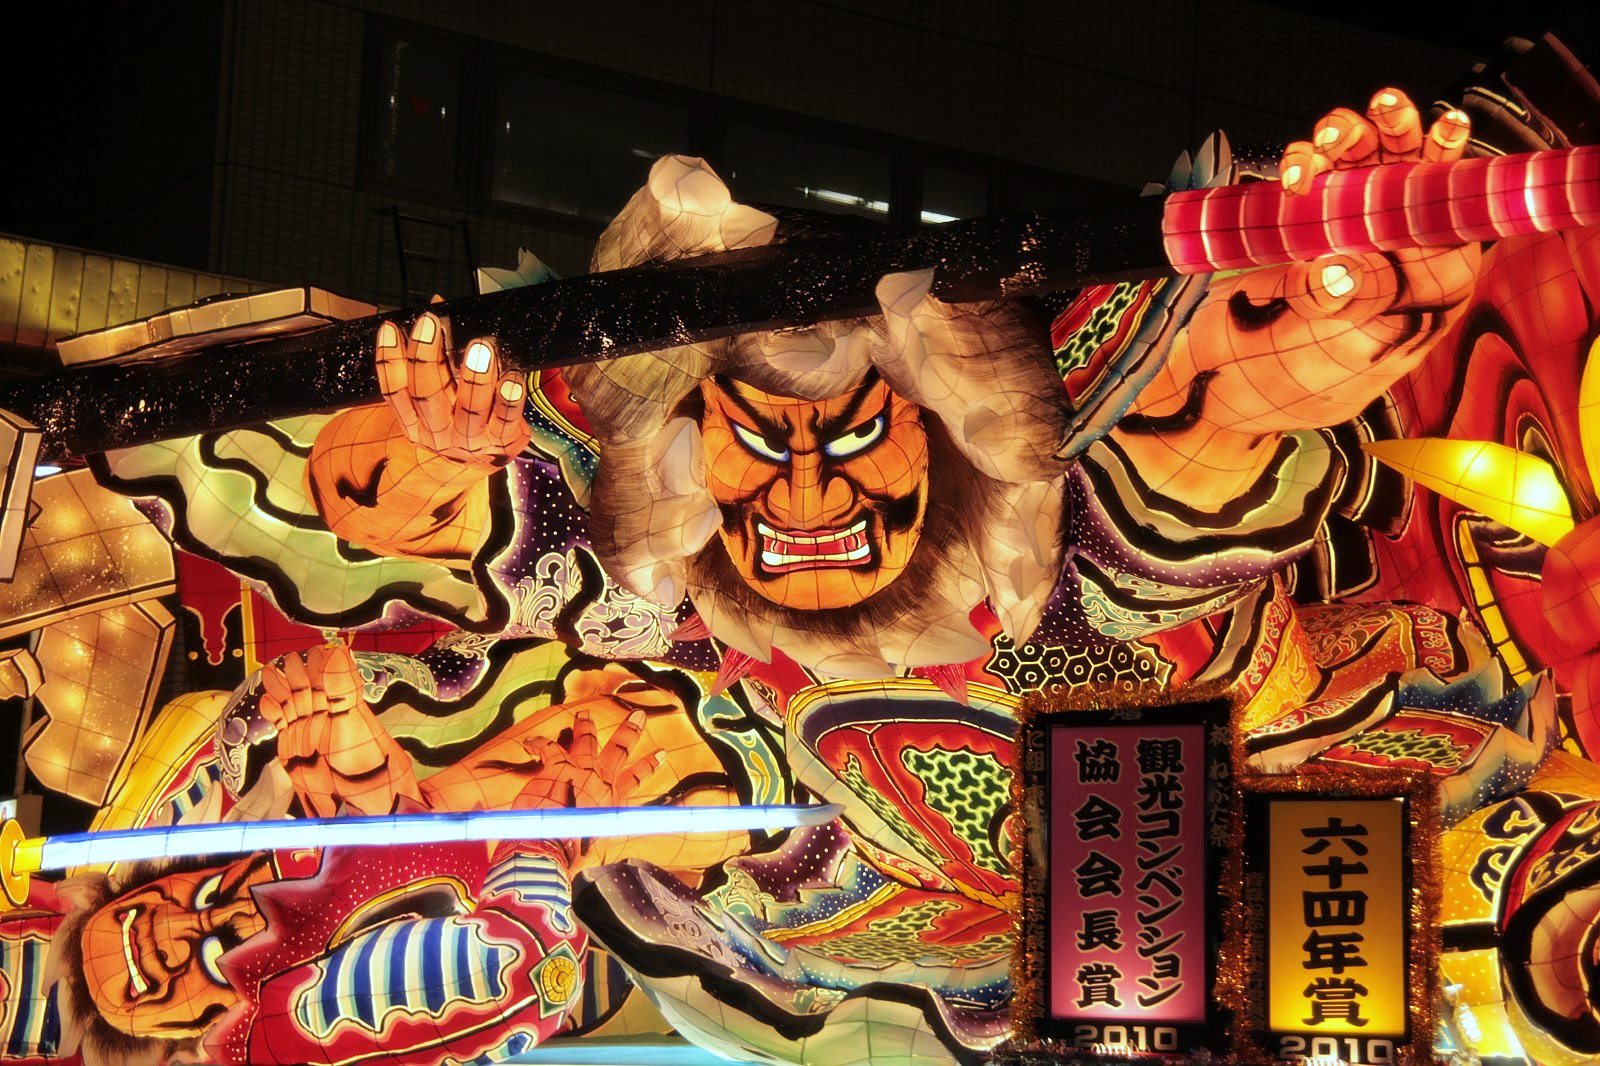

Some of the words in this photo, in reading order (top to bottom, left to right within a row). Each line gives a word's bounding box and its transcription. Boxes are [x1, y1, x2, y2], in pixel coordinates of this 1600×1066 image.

[1072, 738, 1123, 1010] 協会会長賞
[1135, 737, 1185, 1009] 観光コンベンション
[1300, 817, 1369, 1027] 六十四年賞
[1074, 1025, 1178, 1051] 2010
[1279, 1035, 1394, 1066] 2010
